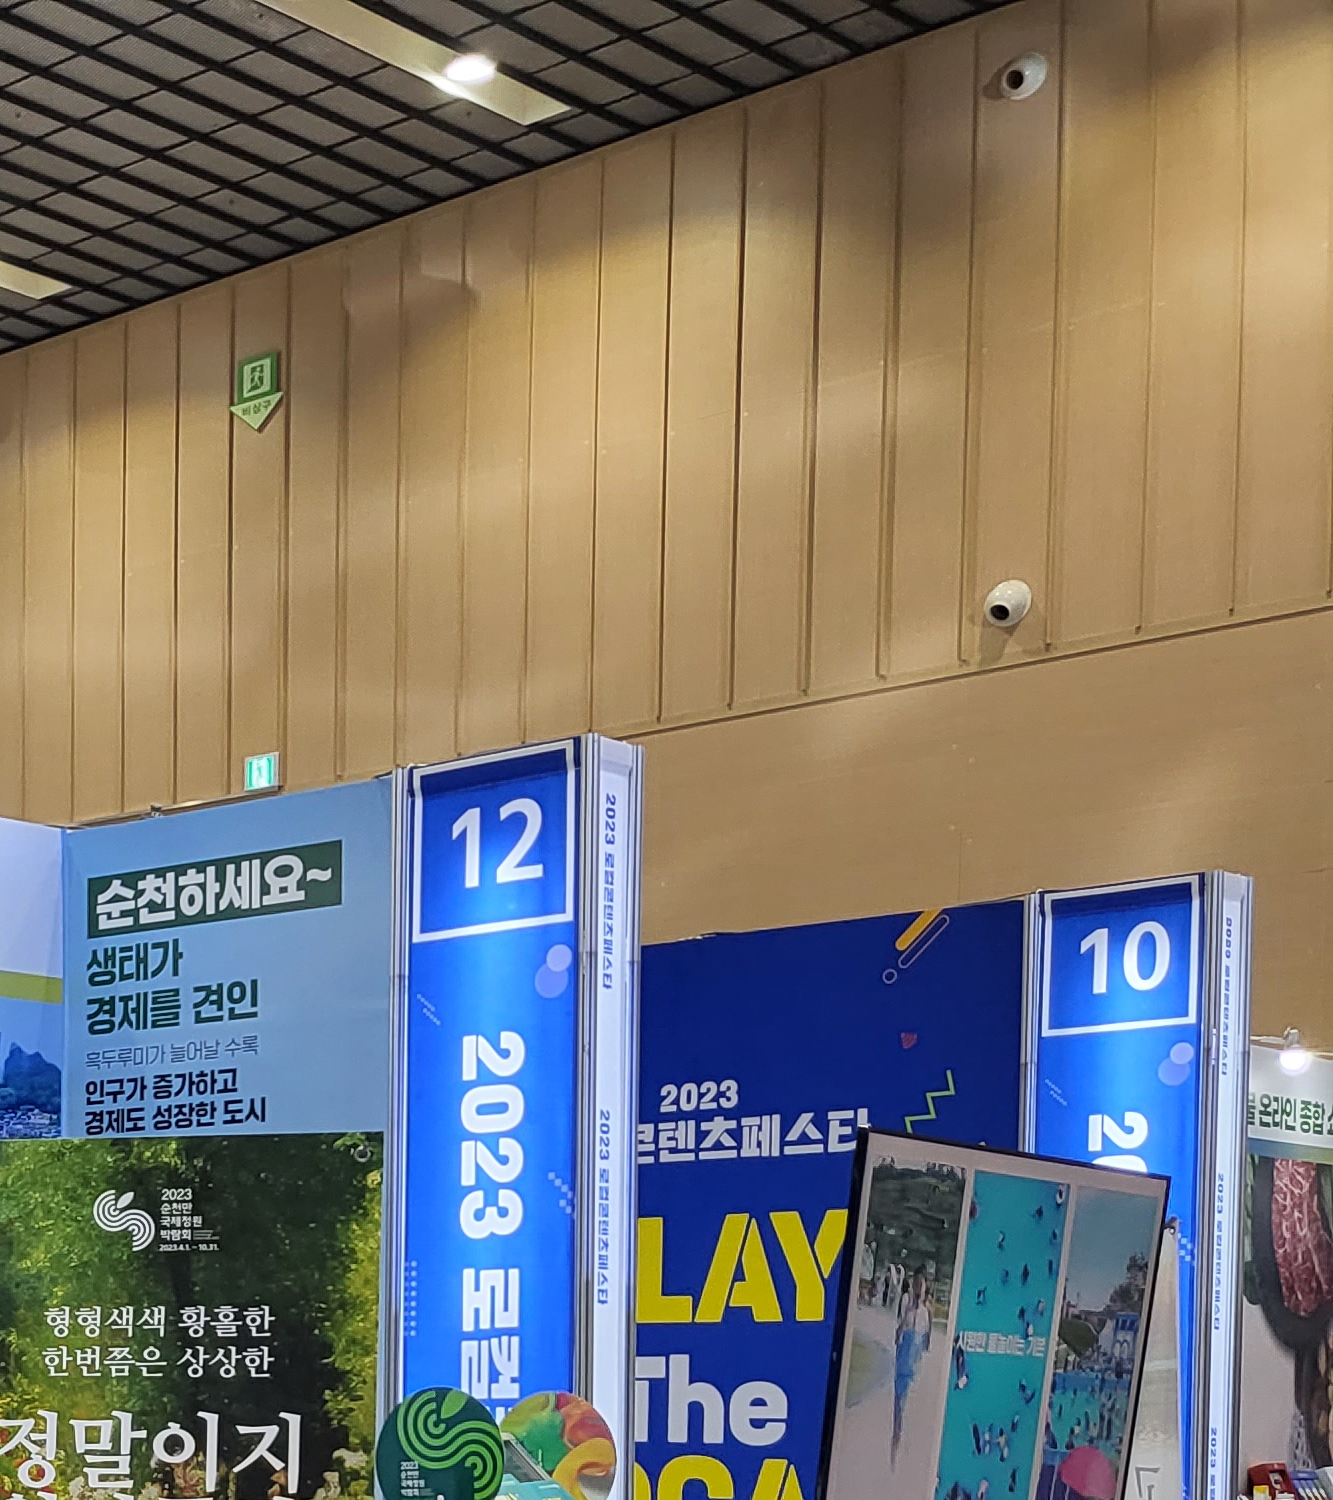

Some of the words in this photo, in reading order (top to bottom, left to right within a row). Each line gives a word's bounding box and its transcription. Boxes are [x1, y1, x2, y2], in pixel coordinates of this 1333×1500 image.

[604, 793, 617, 845] 2023
[450, 797, 545, 890] 12
[95, 853, 333, 931] 순천하세요~
[86, 938, 183, 987] 생태가
[1079, 920, 1172, 995] 10
[86, 987, 182, 1036] 경제를
[192, 979, 259, 1025] 견인
[85, 1045, 167, 1070] 흑두루미가
[169, 1038, 221, 1063] 늘어날
[224, 1034, 260, 1057] 수록
[85, 1075, 148, 1106] 인구가
[152, 1068, 238, 1100] 증가하고
[659, 1079, 740, 1114] 2023
[85, 1107, 146, 1137] 경제도
[152, 1100, 217, 1130] 성장한
[222, 1096, 267, 1125] 도시
[459, 1030, 527, 1240] 2023
[599, 1109, 610, 1161] 2023
[159, 1202, 193, 1215] 순천만
[161, 1188, 193, 1201] 2023
[159, 1215, 203, 1228] 국제정원
[159, 1229, 192, 1241] 박람회
[44, 1305, 167, 1339] 형형색색
[177, 1304, 276, 1339] 황홀한
[41, 1345, 168, 1379] 한번쯤은
[176, 1344, 275, 1379] 상상한
